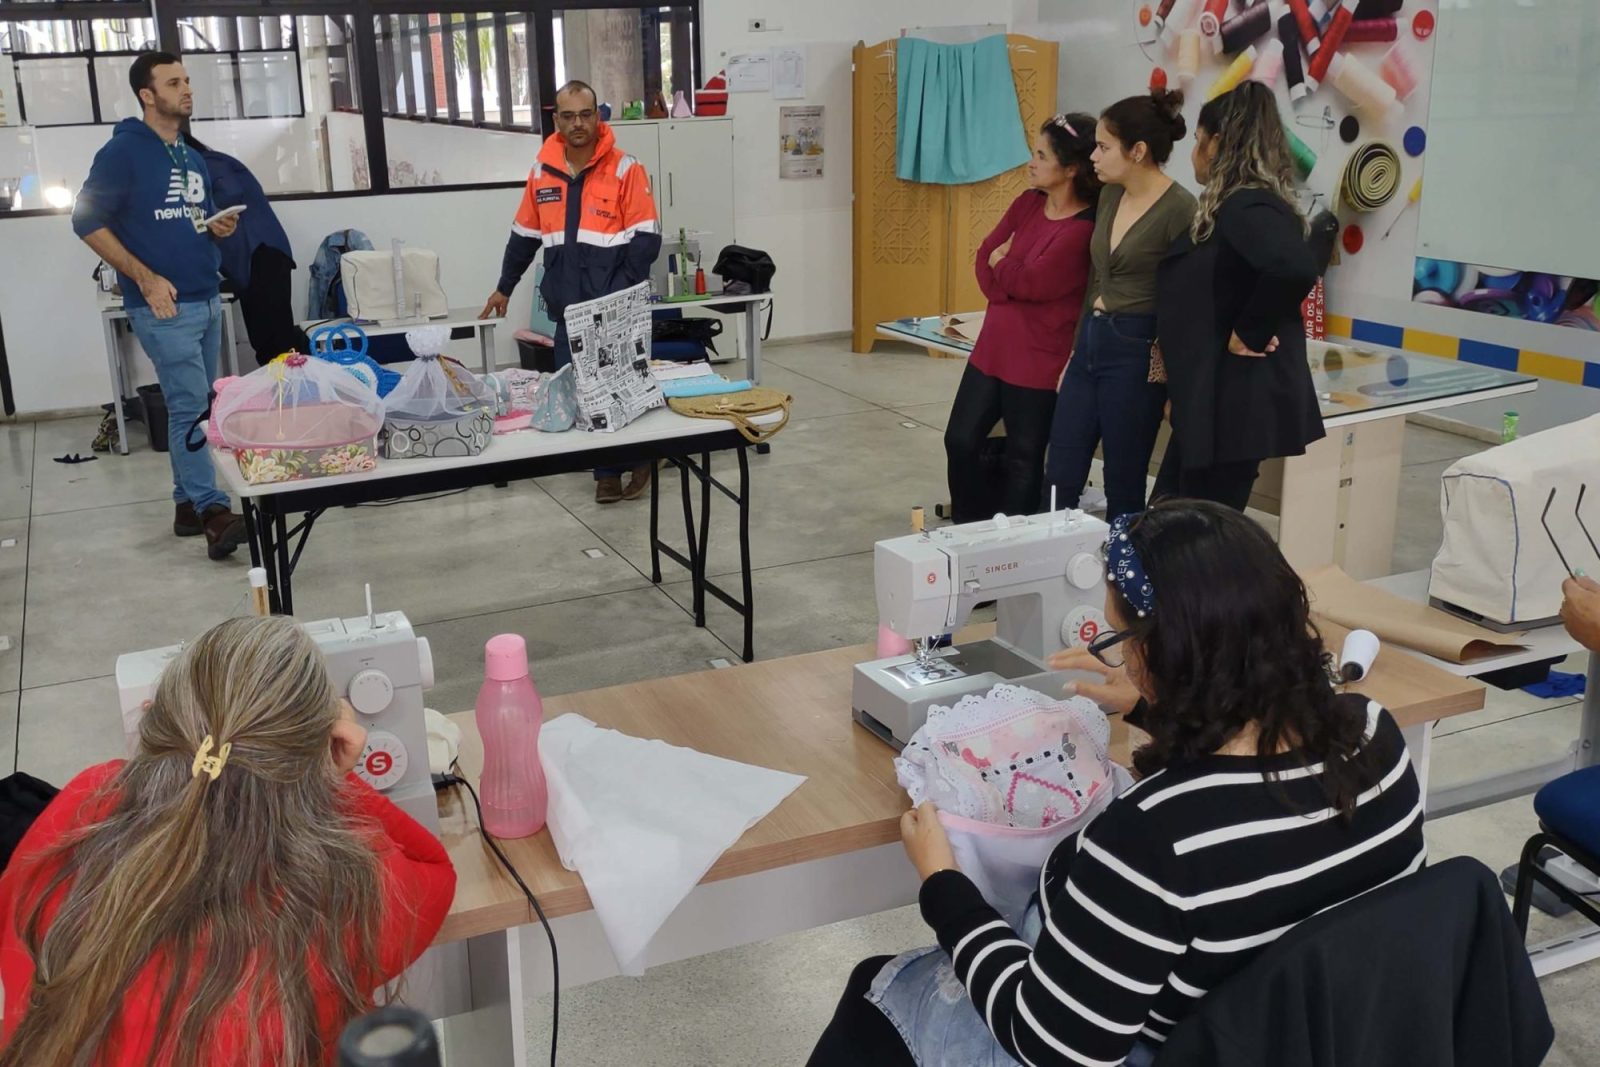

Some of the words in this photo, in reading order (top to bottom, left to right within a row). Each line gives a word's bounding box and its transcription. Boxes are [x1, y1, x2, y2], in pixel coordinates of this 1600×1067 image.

[154, 207, 182, 220] new
[1307, 303, 1315, 317] OS
[1316, 308, 1323, 322] DE
[985, 562, 1019, 574] SINGER
